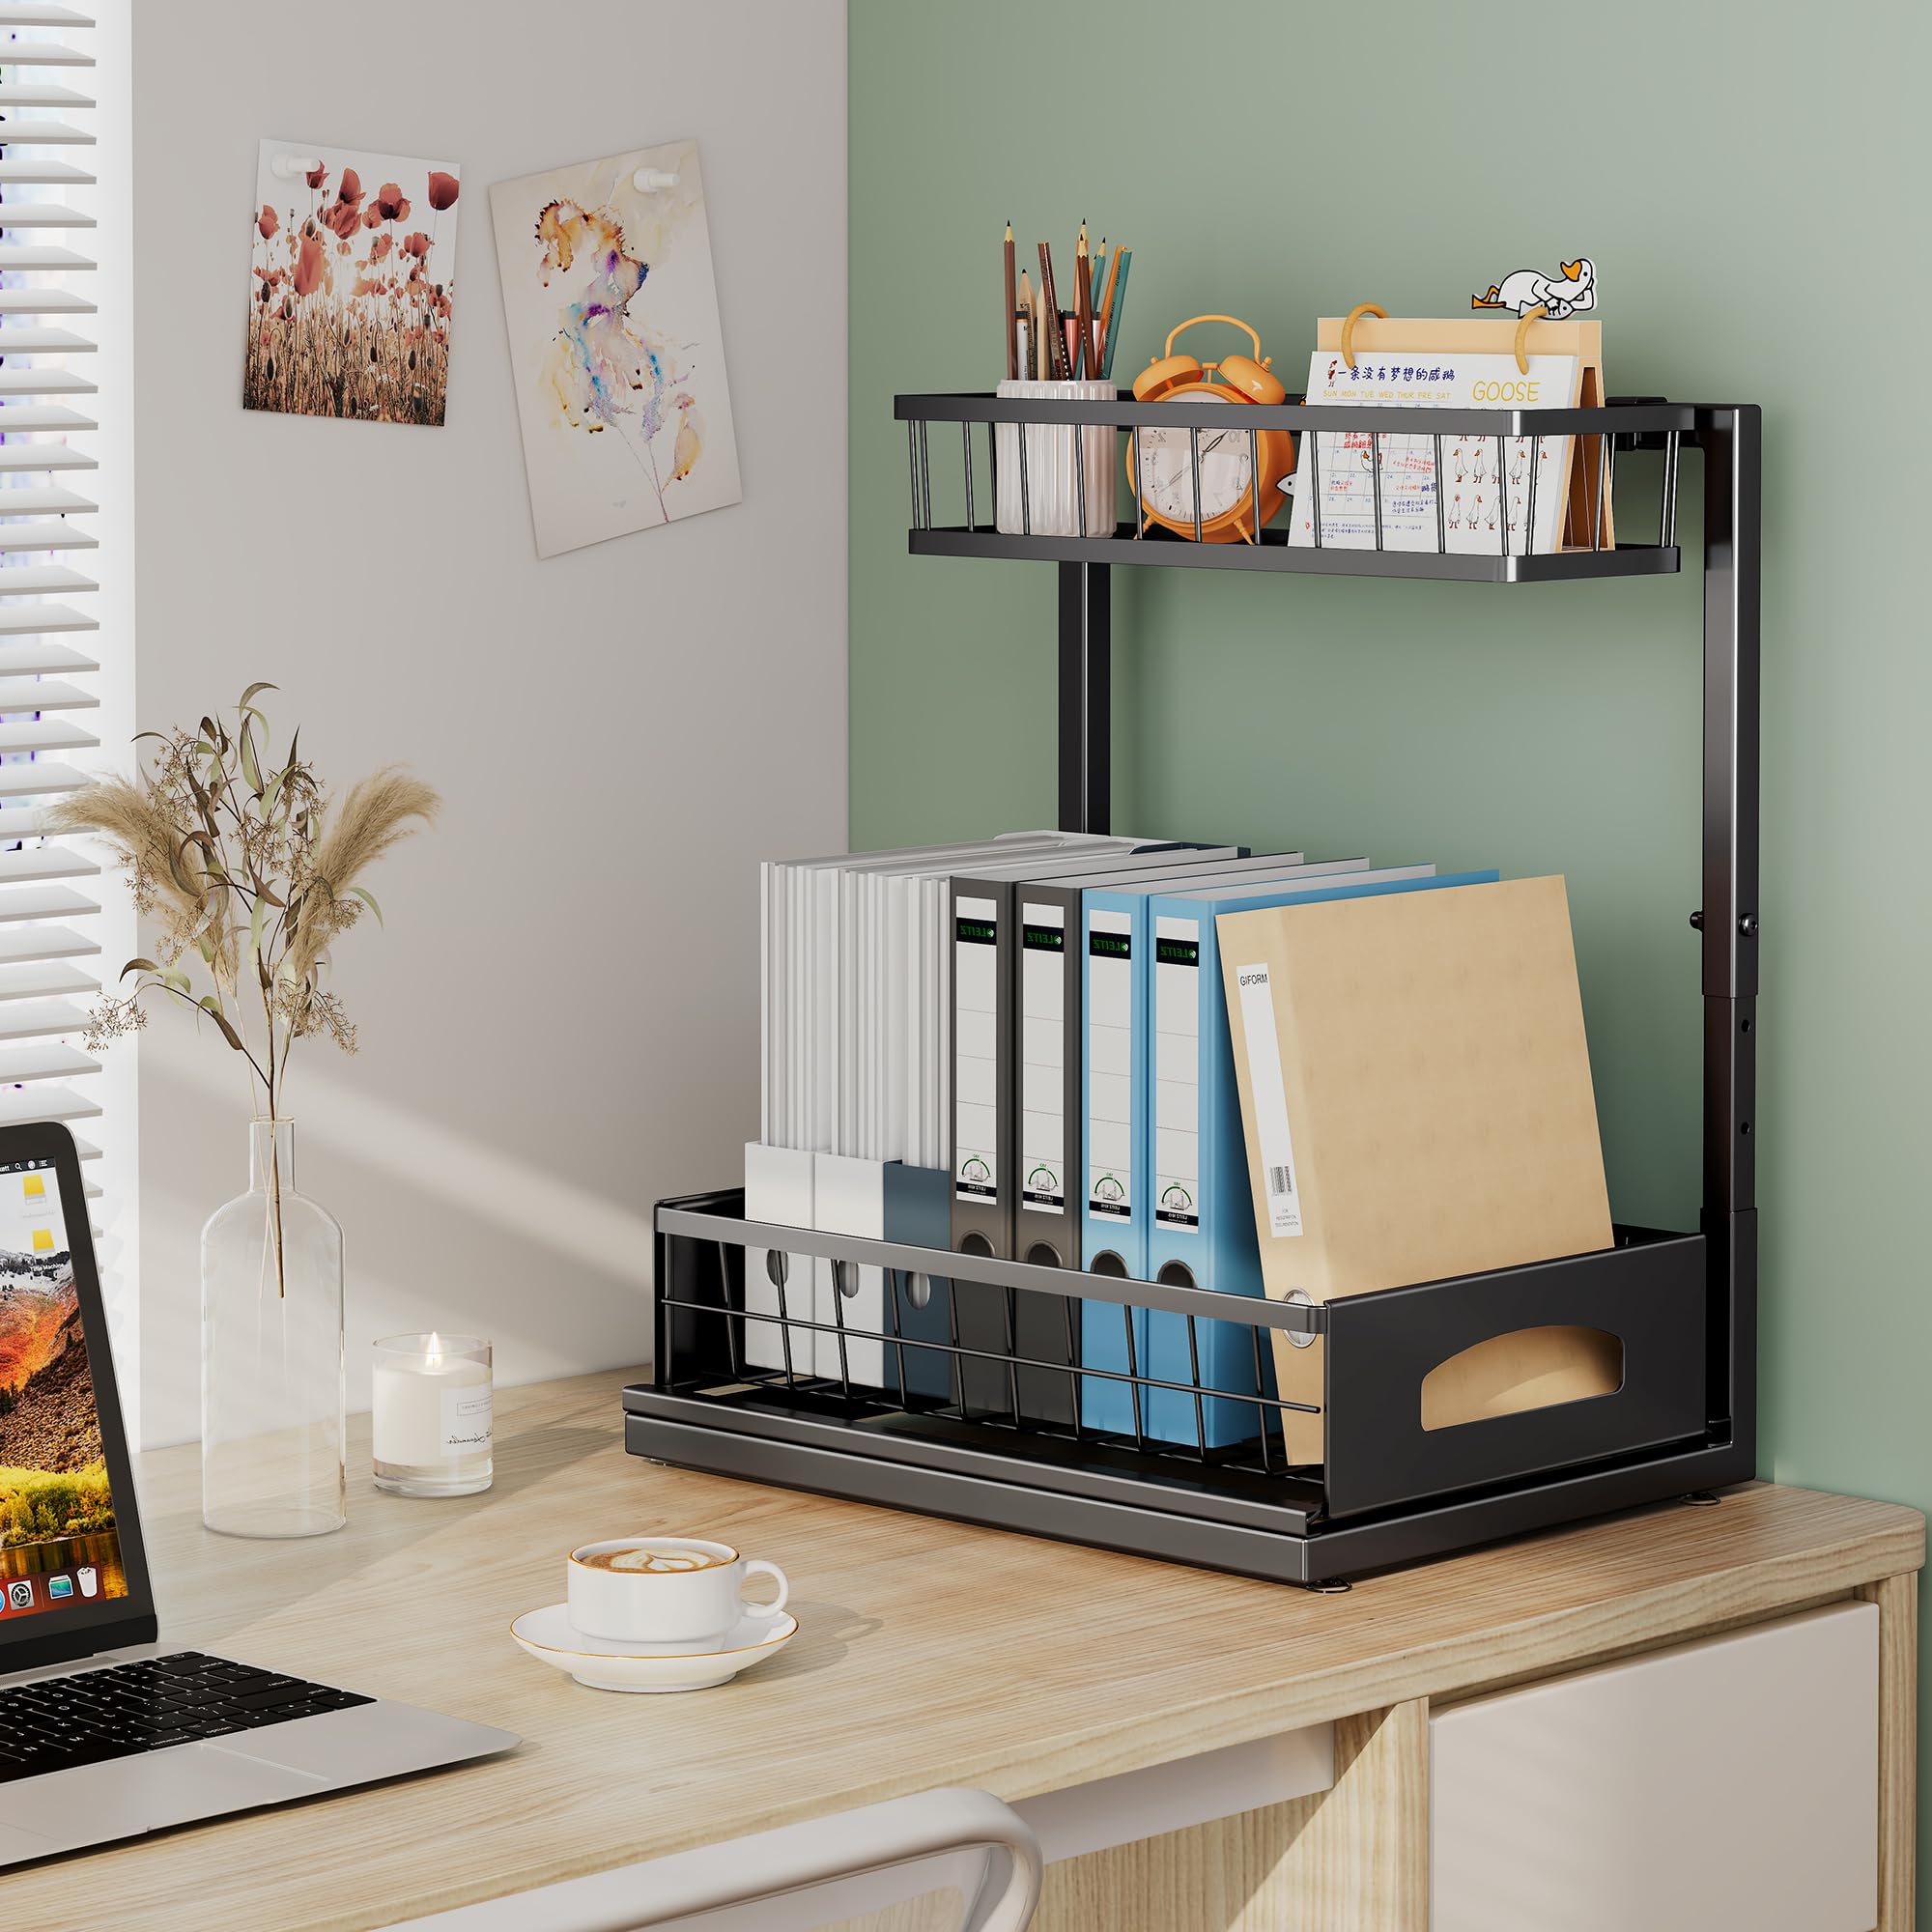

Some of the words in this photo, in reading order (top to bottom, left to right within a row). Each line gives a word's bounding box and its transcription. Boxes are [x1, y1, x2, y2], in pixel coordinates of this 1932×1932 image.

[1341, 389, 1356, 398] MON
[1378, 390, 1394, 399] WED
[1436, 389, 1452, 400] SAT
[1473, 381, 1540, 402] GOOSE
